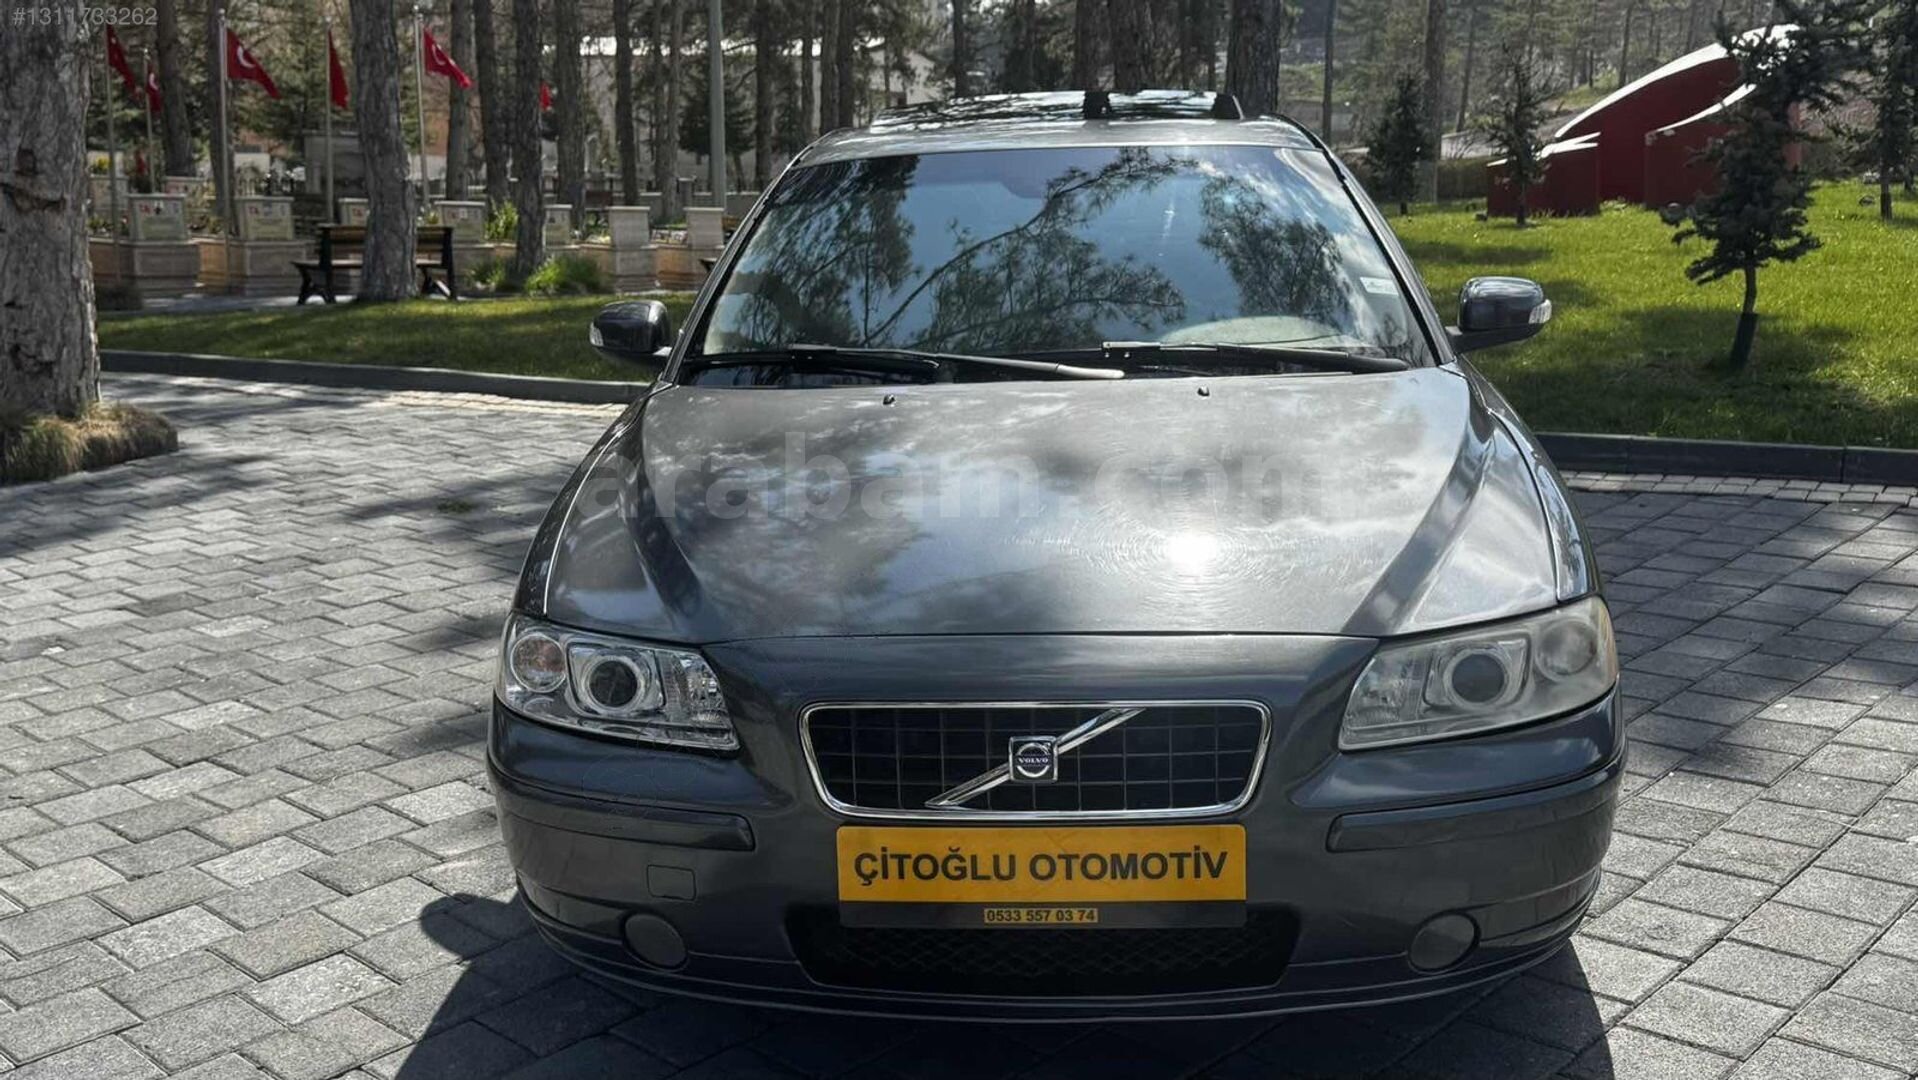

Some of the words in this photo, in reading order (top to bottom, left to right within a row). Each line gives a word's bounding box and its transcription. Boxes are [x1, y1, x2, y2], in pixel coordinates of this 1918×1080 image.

[854, 846, 1016, 886] ÇİTOĞLU
[1029, 845, 1228, 880] OTOMOTİV
[987, 909, 1021, 921] 0533
[1026, 909, 1051, 921] 557
[1056, 909, 1073, 921] 03
[1077, 909, 1095, 921] 74
